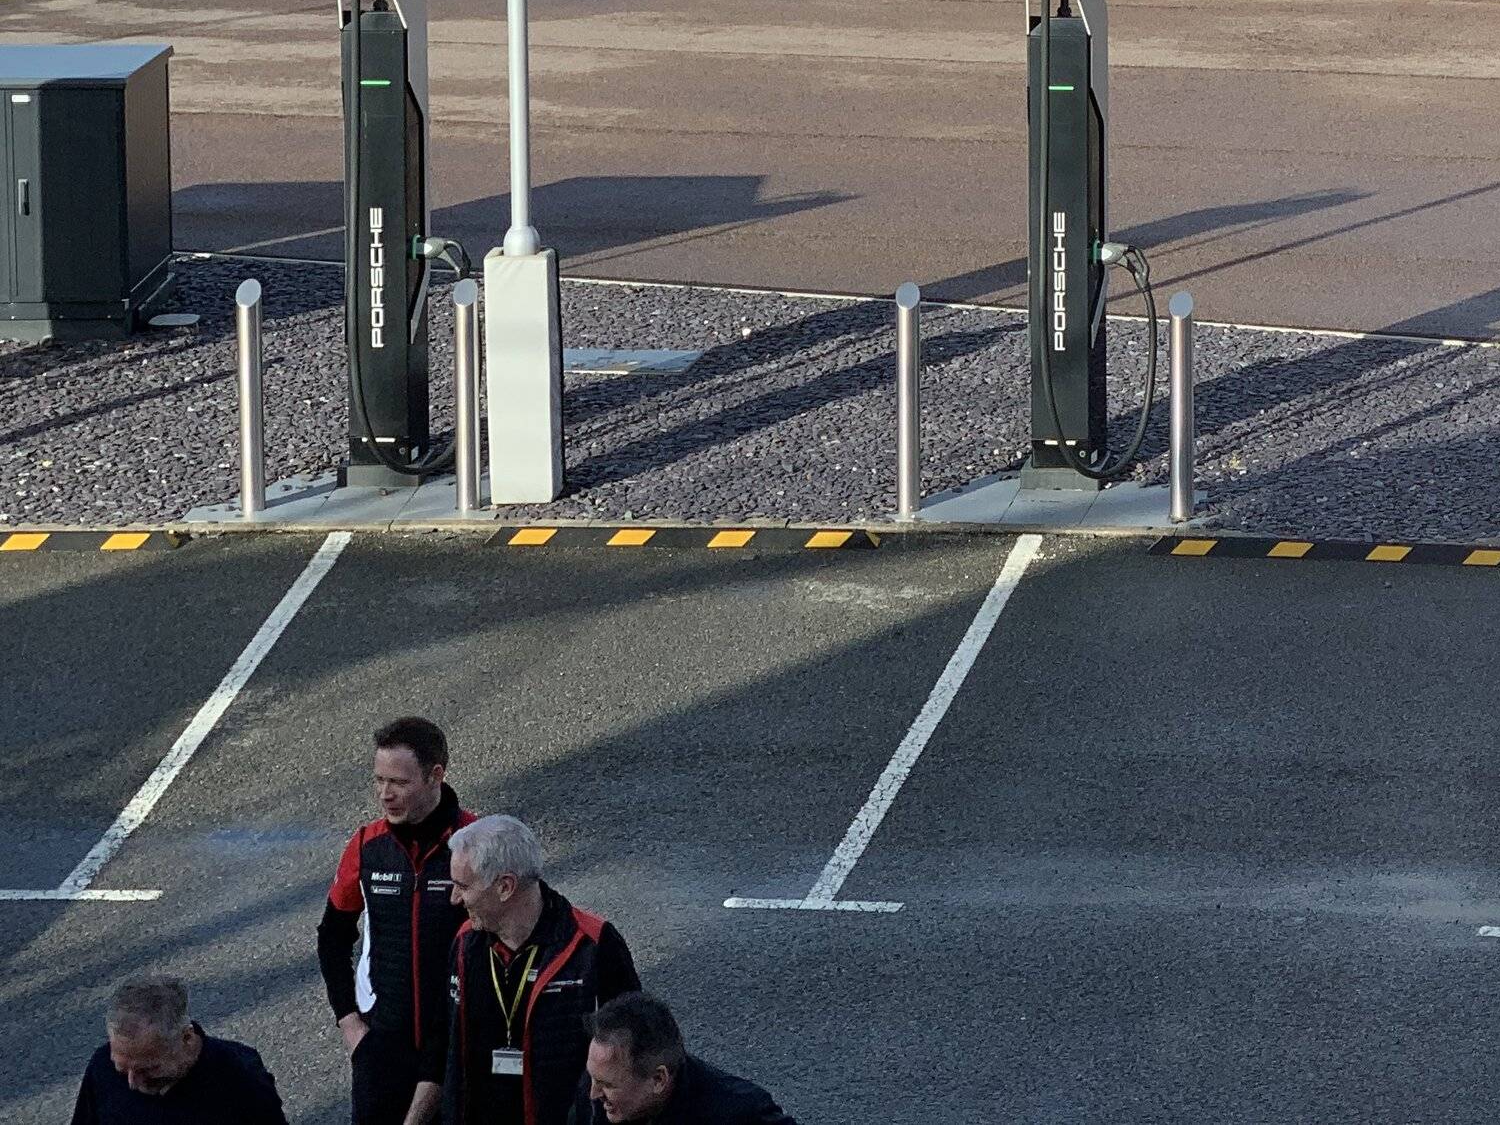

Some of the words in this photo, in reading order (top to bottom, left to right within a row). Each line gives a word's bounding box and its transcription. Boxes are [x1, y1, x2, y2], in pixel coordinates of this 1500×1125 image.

[369, 207, 385, 348] PORSCHE
[1053, 212, 1066, 351] PORSCHE
[371, 872, 394, 882] Mobil
